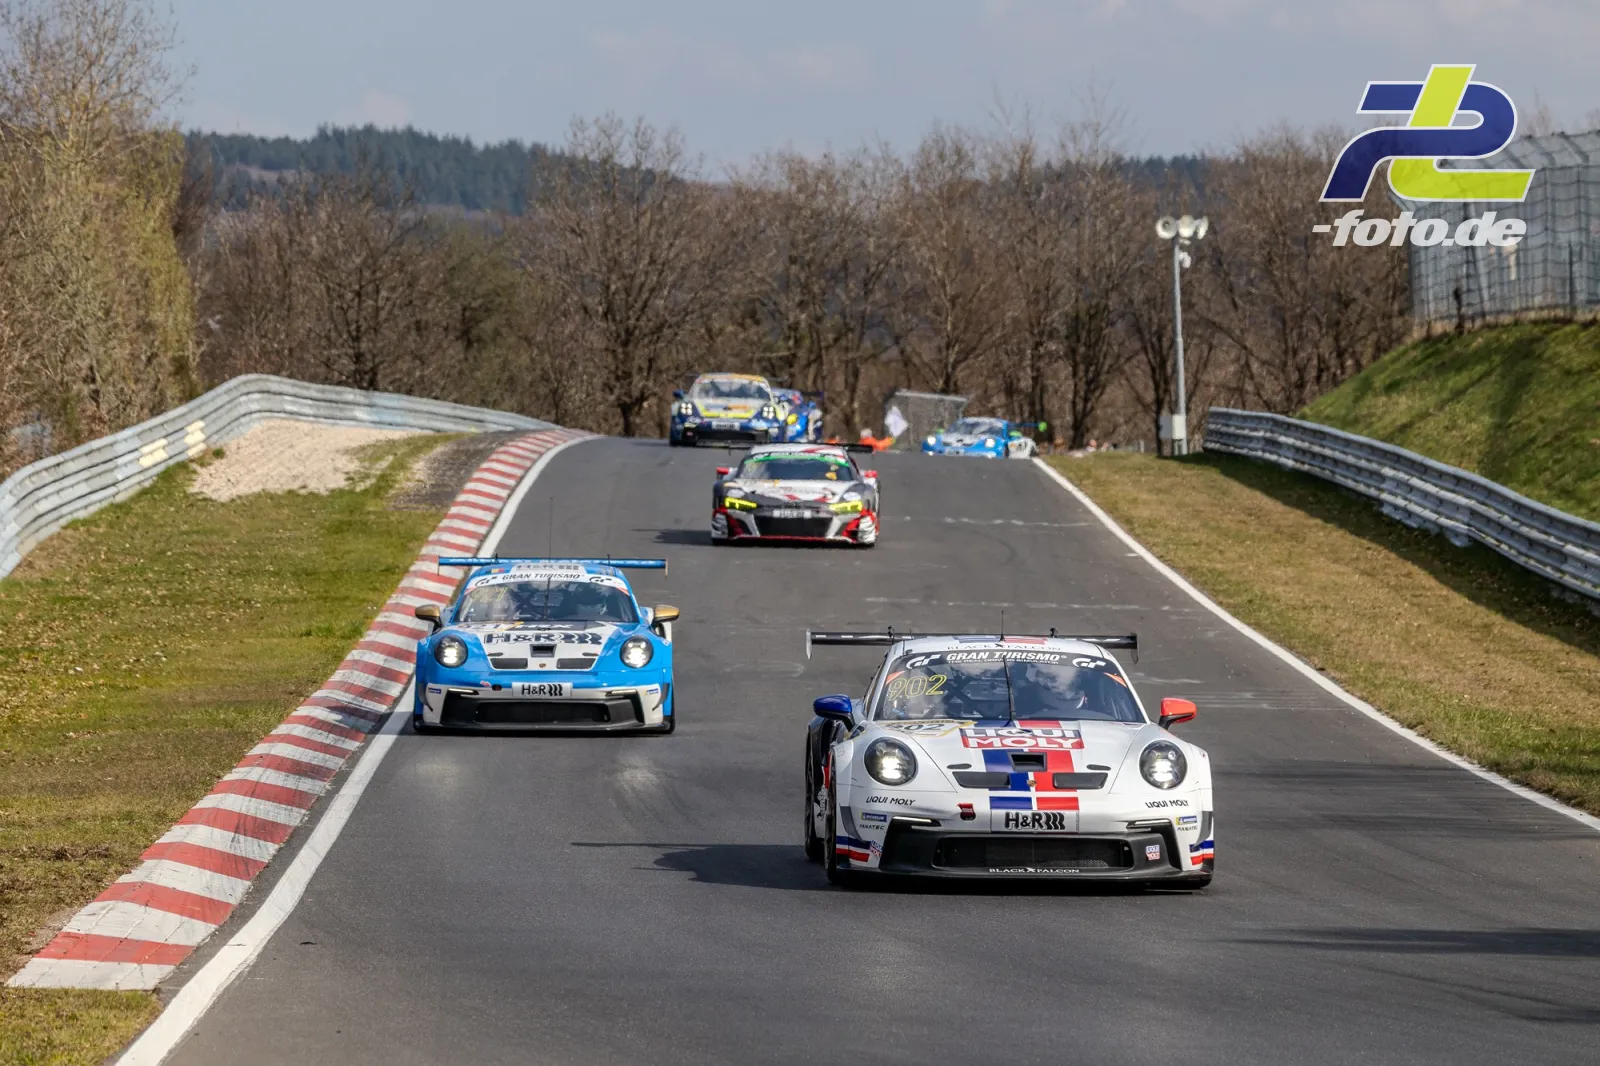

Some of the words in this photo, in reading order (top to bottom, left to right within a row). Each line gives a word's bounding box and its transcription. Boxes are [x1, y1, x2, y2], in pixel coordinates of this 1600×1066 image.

[946, 651, 990, 661] GRAN
[994, 651, 1061, 661] TURISMO
[522, 684, 548, 696] H&R
[888, 674, 947, 702] 902
[965, 728, 1077, 738] LIQUI
[968, 737, 1081, 748] MOLY
[866, 796, 888, 804] LIQUI
[890, 797, 916, 806] MOLY
[1144, 800, 1169, 808] LIQUI
[1169, 799, 1189, 807] MOLY
[1004, 812, 1043, 829] H&R
